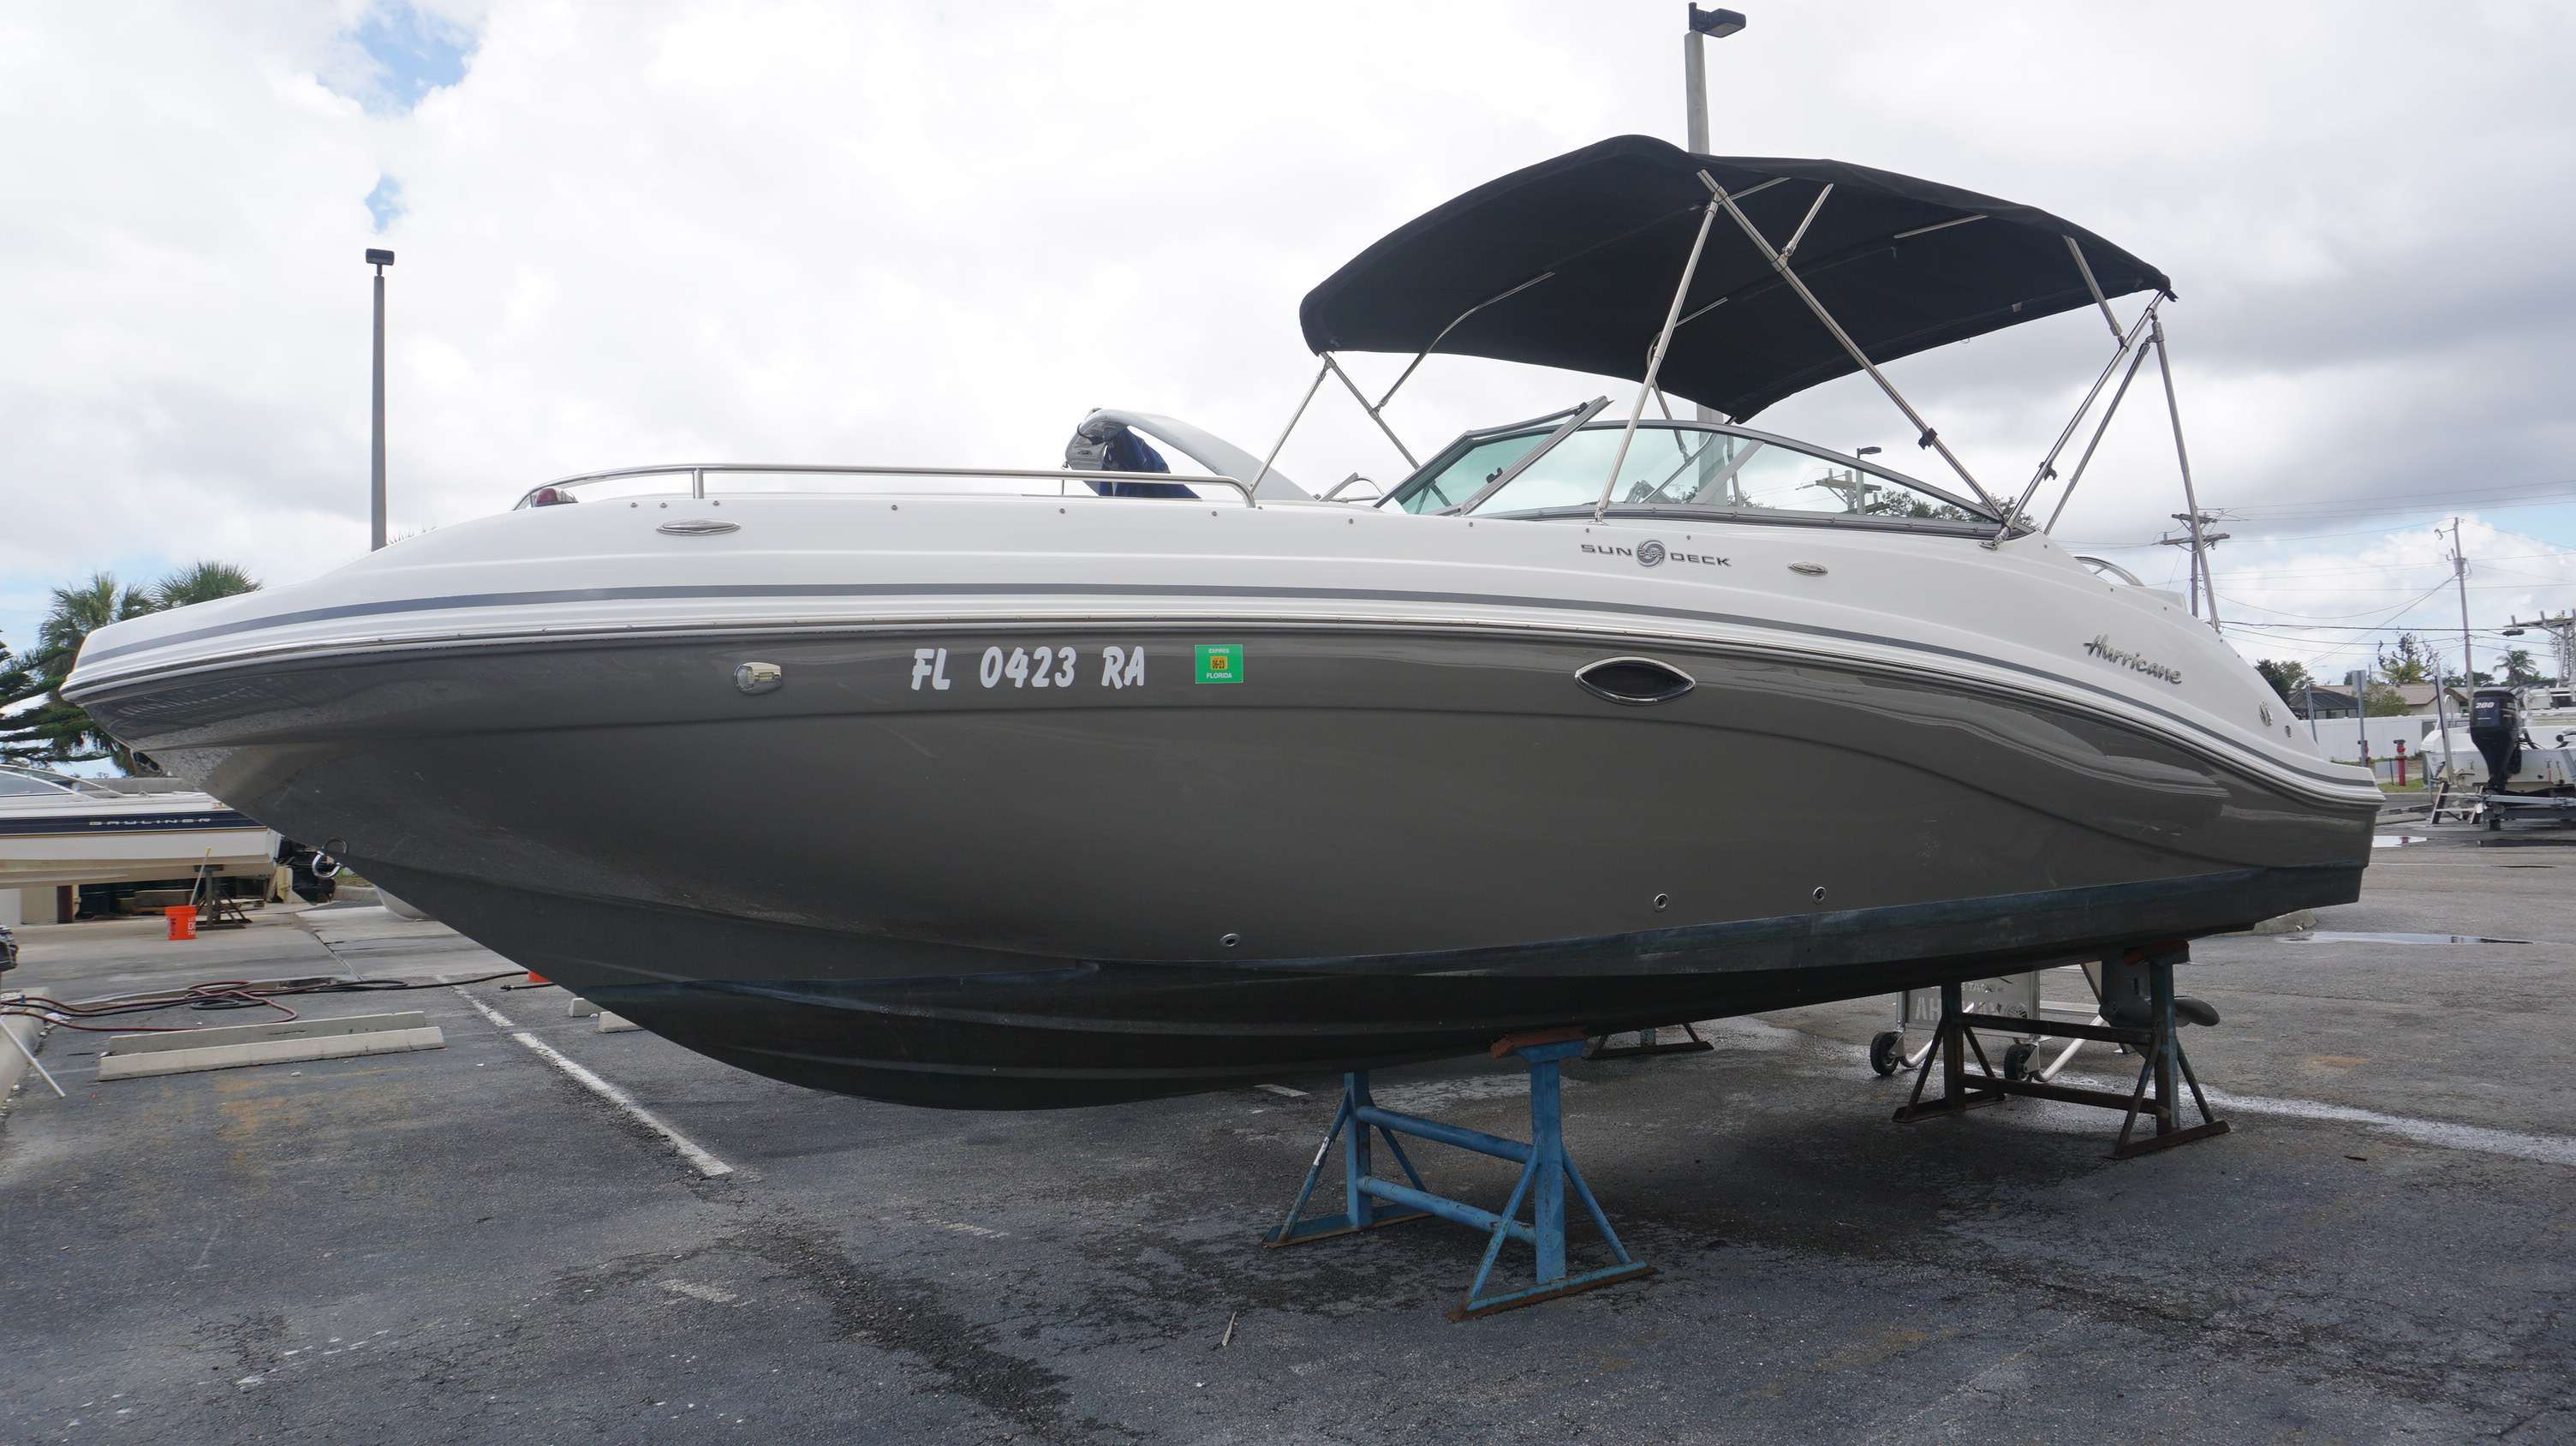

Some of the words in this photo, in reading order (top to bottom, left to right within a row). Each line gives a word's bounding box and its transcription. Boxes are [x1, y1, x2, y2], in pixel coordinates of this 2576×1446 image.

[1581, 544, 1632, 556] SUN
[1670, 553, 1732, 567] DECK
[911, 648, 951, 690] FL
[980, 646, 1076, 688] 0423
[1101, 646, 1144, 690] RA
[2083, 634, 2182, 684] Hurricane
